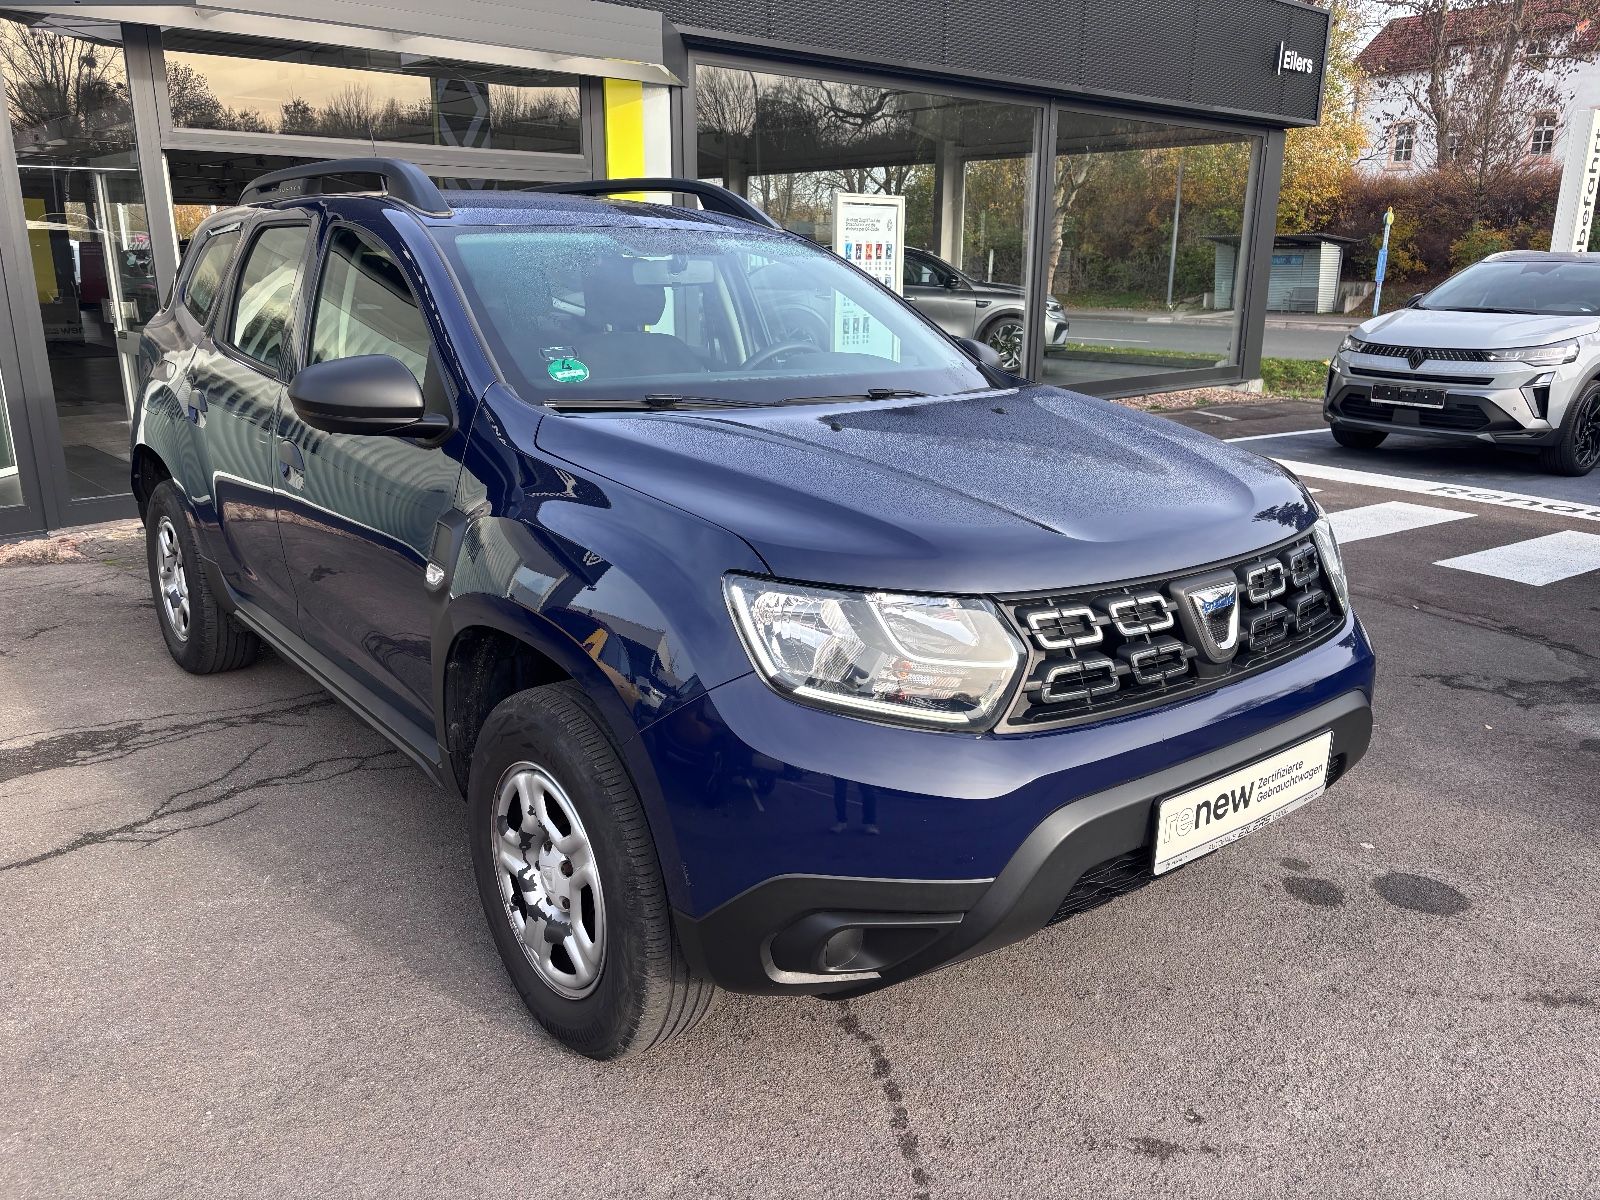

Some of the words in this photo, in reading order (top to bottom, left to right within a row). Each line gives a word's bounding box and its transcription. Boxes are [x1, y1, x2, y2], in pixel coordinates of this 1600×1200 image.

[1283, 50, 1313, 74] Eilers
[1576, 128, 1600, 252] befahrt
[1256, 764, 1323, 803] Gebrauchtwagen
[1257, 760, 1304, 790] Zertifizierte
[1164, 780, 1255, 844] renew
